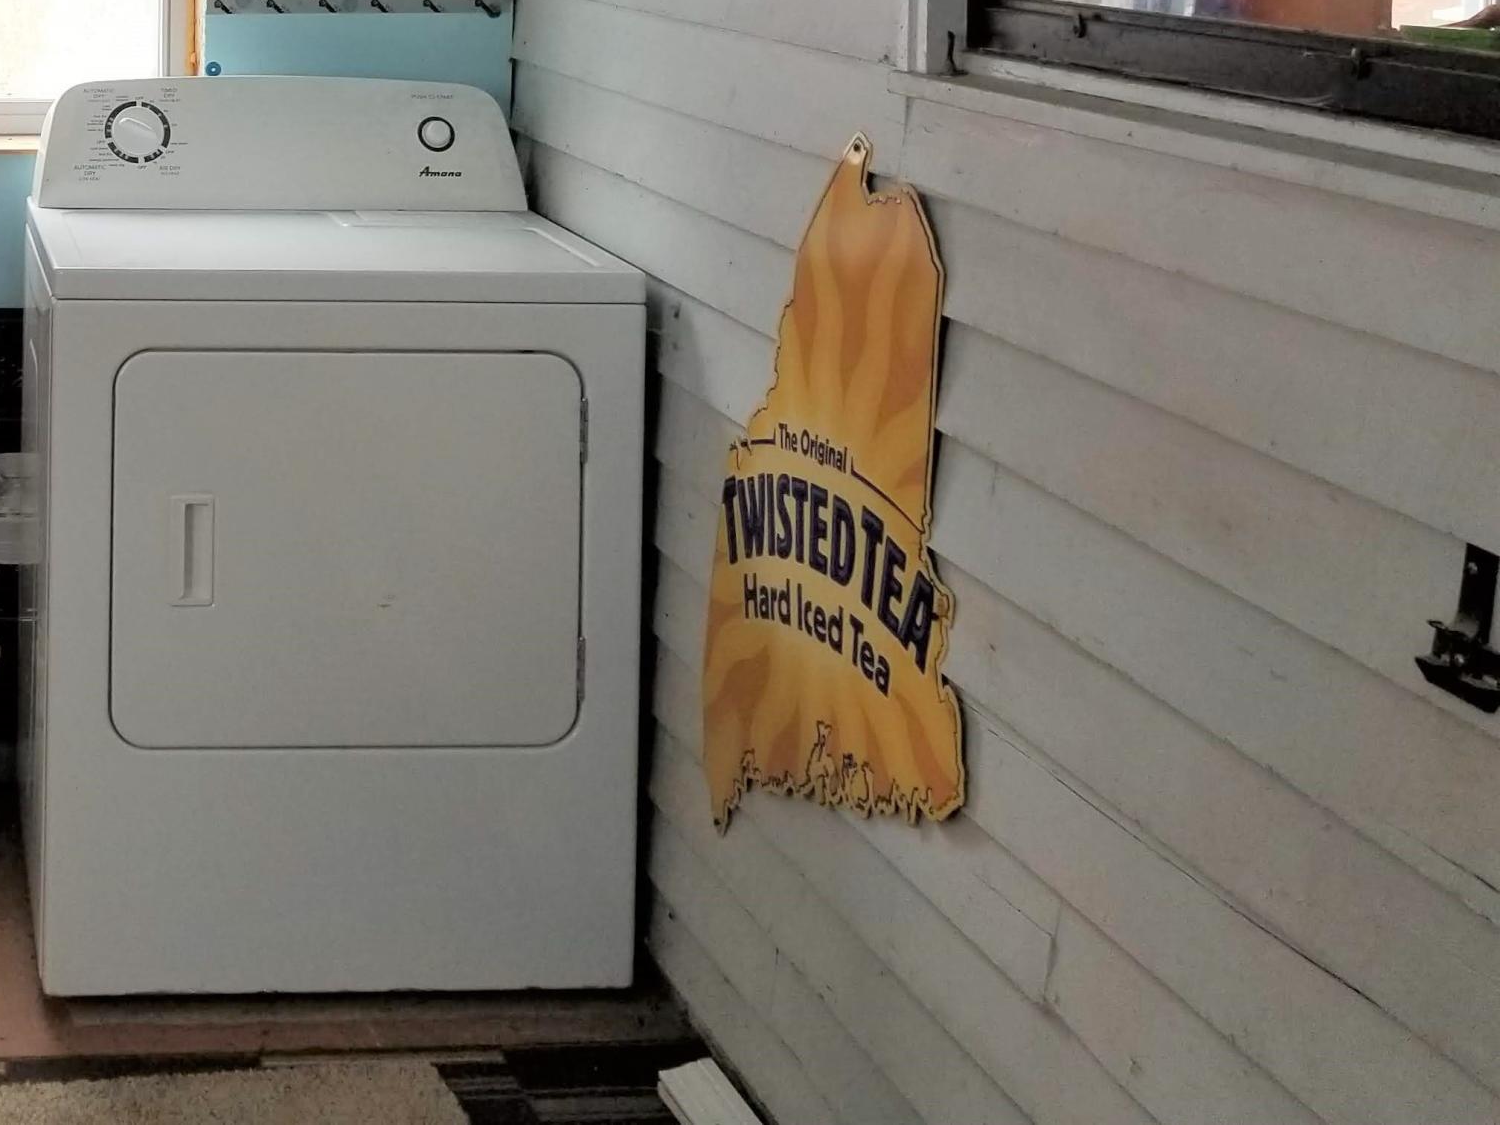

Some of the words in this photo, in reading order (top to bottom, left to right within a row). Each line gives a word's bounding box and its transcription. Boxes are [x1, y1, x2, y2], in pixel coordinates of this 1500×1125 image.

[419, 166, 462, 177] Amana
[778, 423, 798, 453] The
[800, 429, 848, 474] Original
[721, 473, 856, 587] TWISTED
[860, 505, 935, 675] TEA
[743, 572, 791, 626] Hard
[796, 582, 844, 655] Iced
[849, 613, 891, 698] Tea
